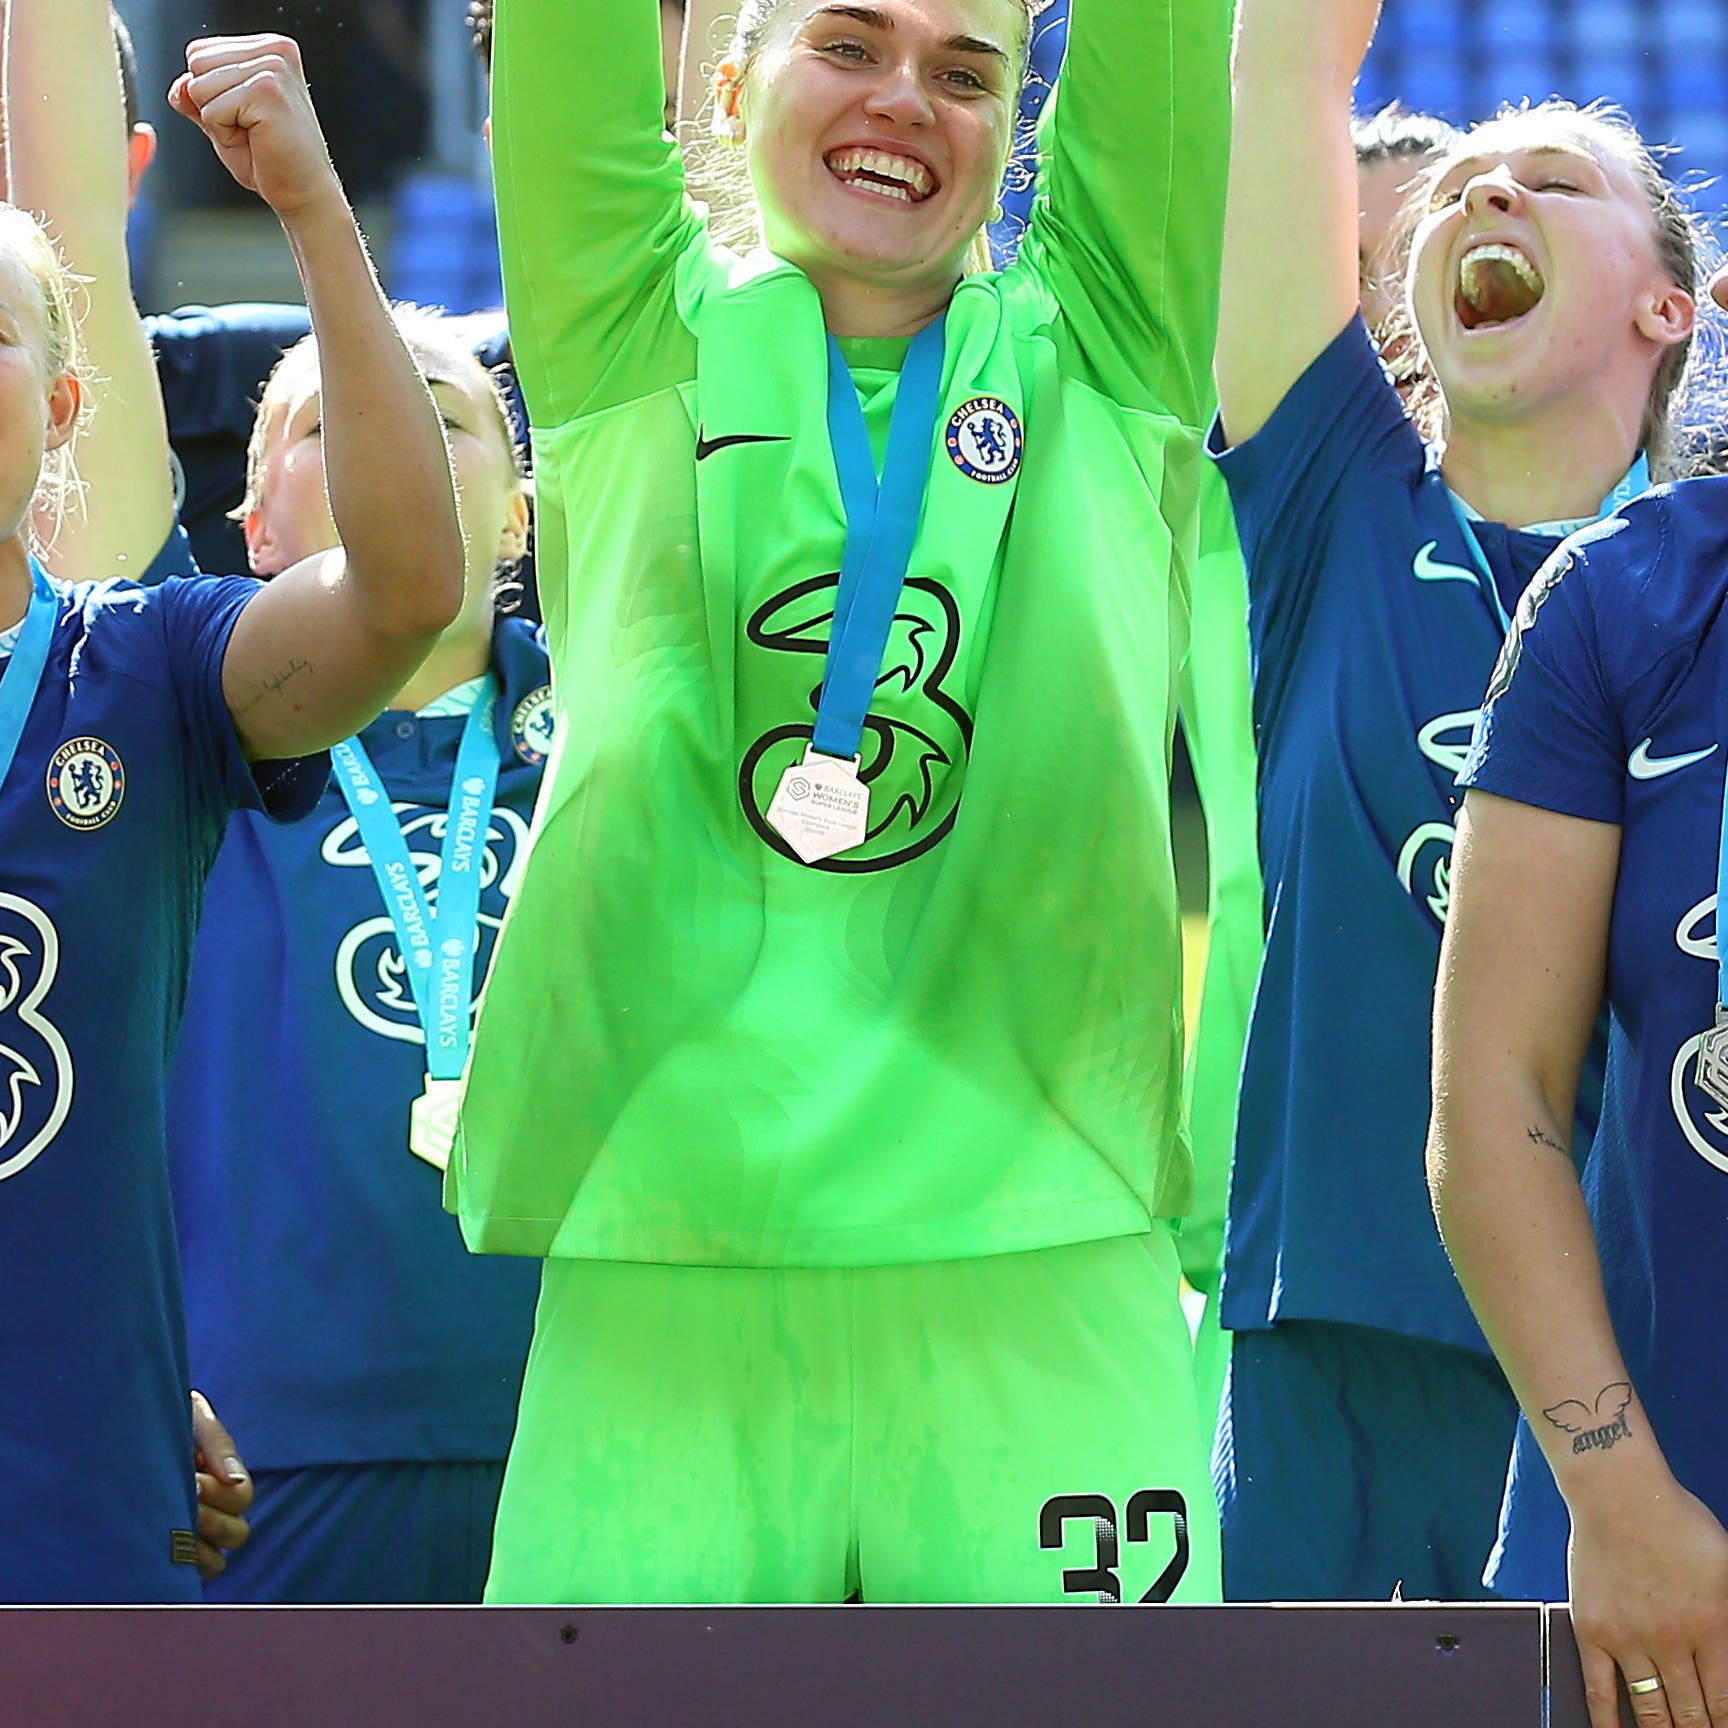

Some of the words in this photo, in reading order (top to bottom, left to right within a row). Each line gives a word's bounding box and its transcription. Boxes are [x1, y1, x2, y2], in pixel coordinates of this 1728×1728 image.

[952, 399, 1004, 426] CHELSEA
[55, 741, 105, 766] CHELSEA
[812, 792, 859, 809] WOMEN'S
[452, 797, 480, 872] BARCLAYS
[385, 861, 430, 947] BARCLAYS
[439, 958, 461, 1048] BARCLAYS
[1573, 1412, 1632, 1454] angel
[1039, 1489, 1190, 1603] 32
